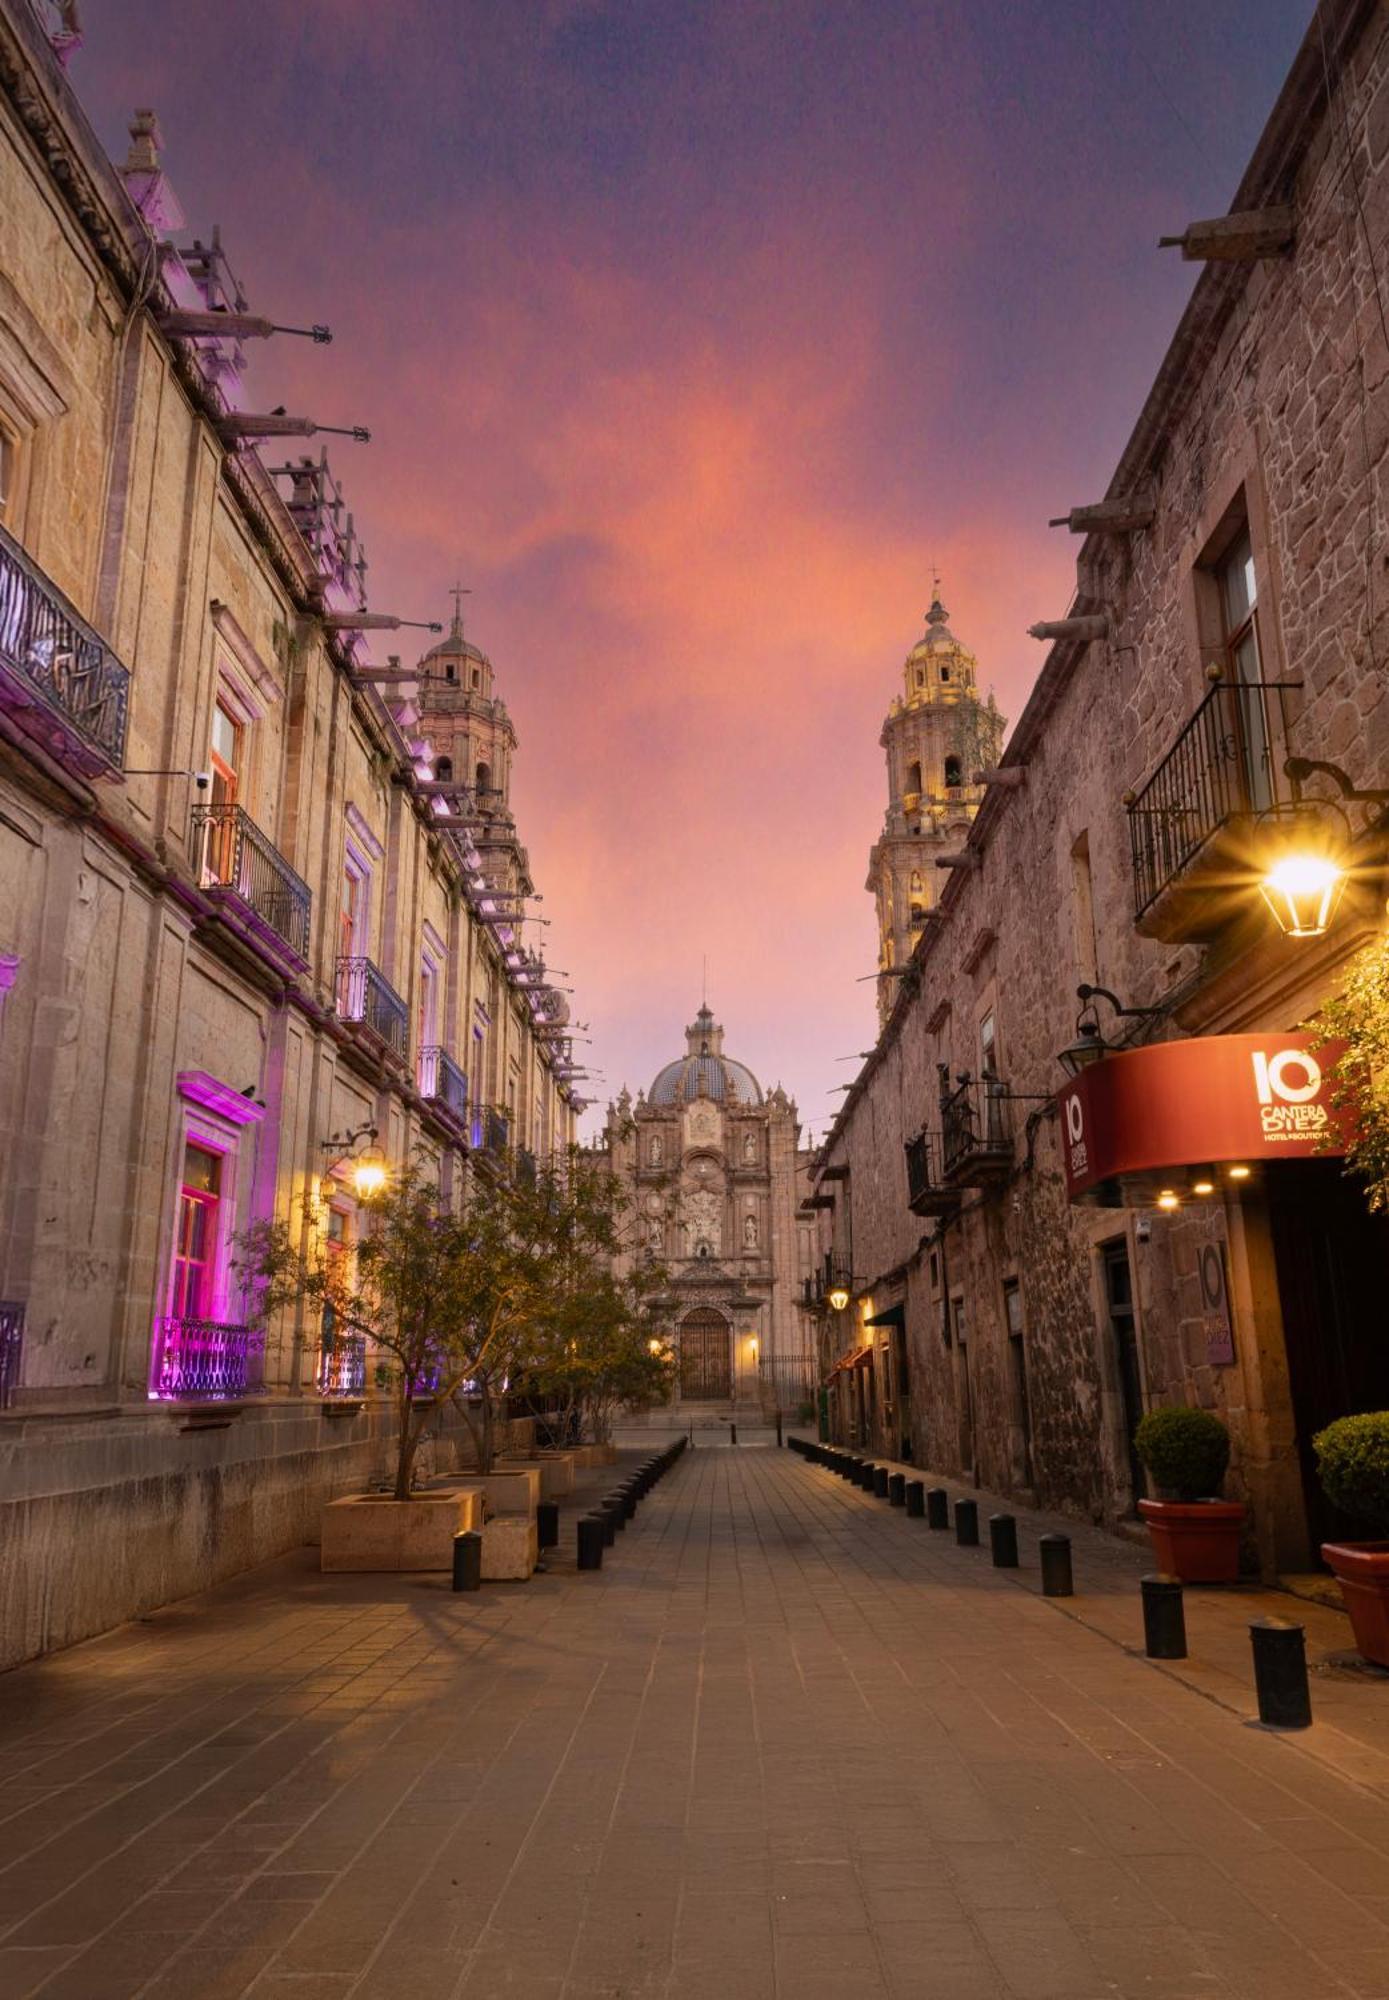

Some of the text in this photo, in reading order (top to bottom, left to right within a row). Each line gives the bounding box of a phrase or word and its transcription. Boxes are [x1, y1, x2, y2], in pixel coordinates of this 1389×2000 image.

[1253, 1050, 1321, 1104] 10
[1066, 1095, 1083, 1146] 10
[1260, 1104, 1328, 1121] CANTERA
[1262, 1118, 1328, 1132] DIEZ
[1264, 1133, 1288, 1142] HOTEL
